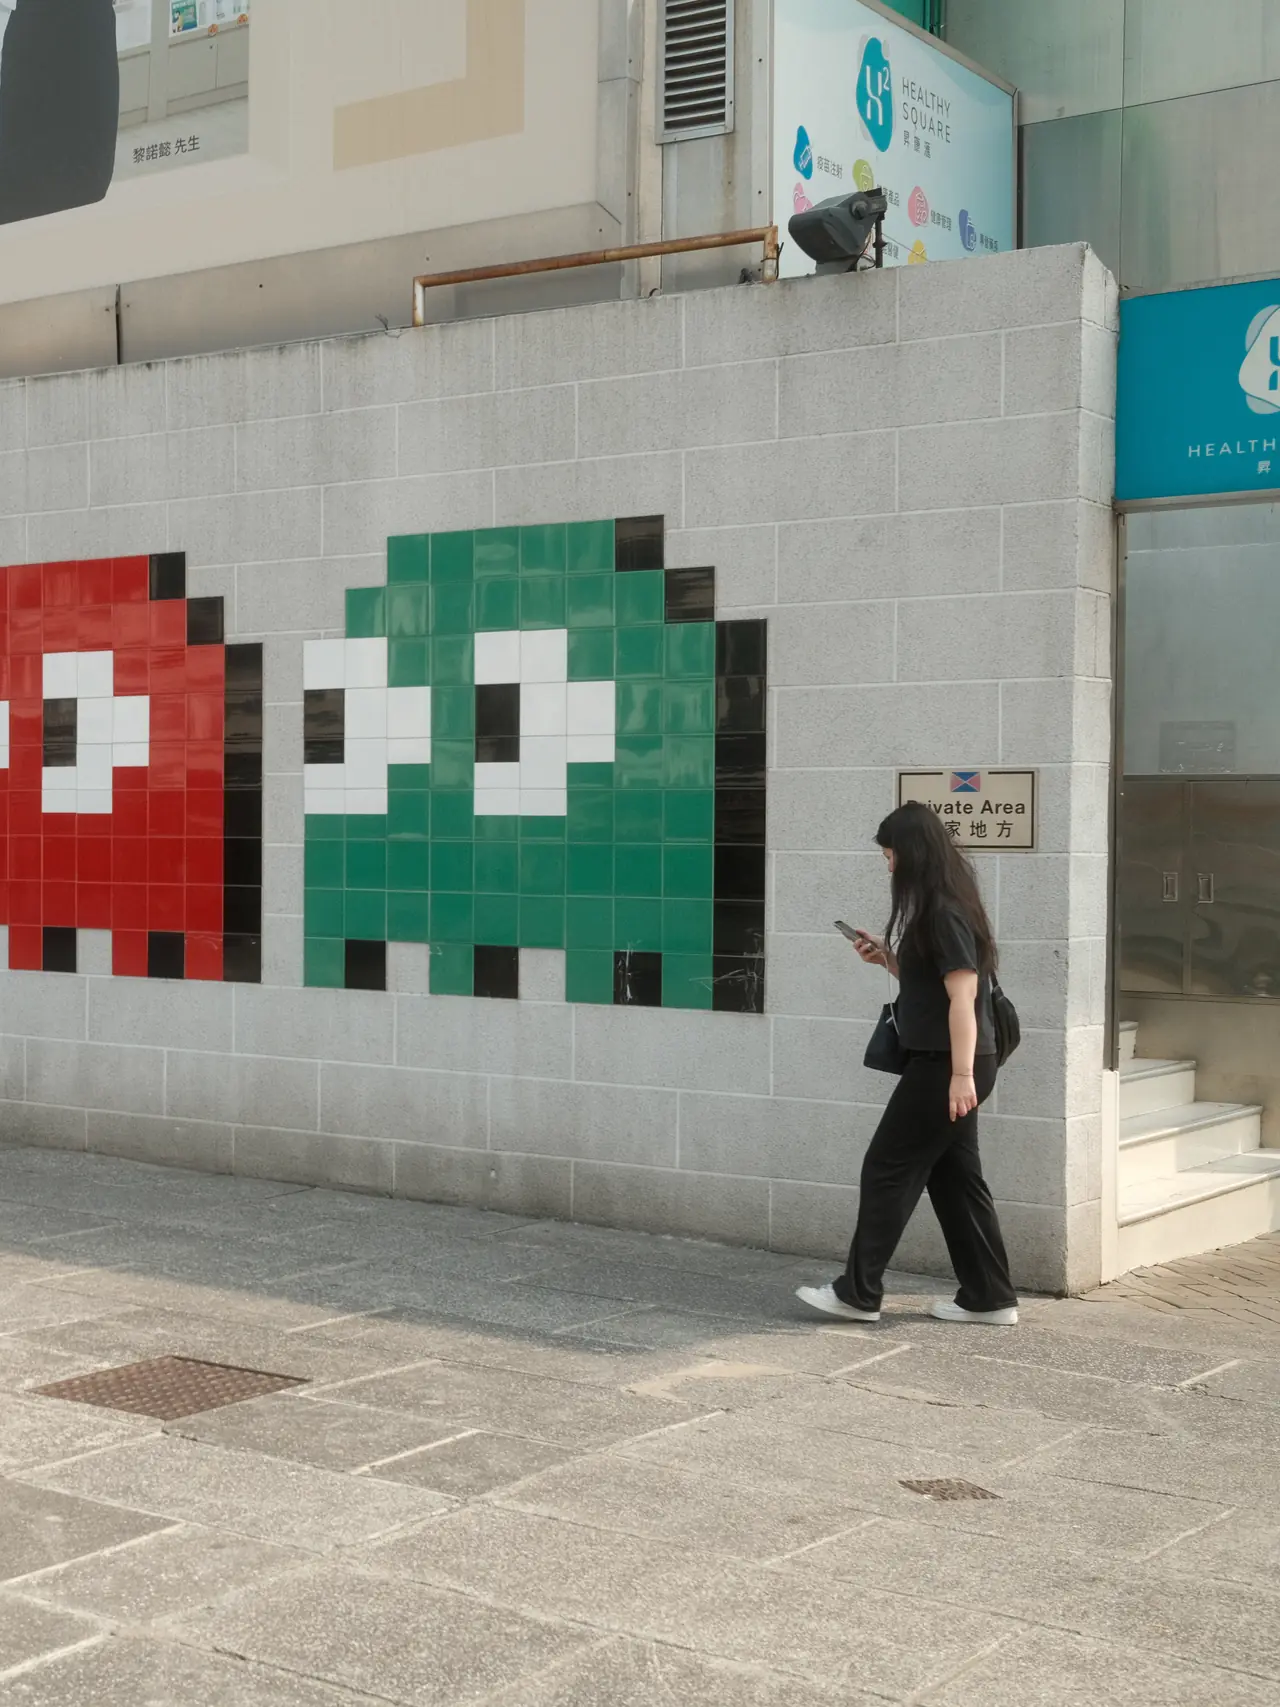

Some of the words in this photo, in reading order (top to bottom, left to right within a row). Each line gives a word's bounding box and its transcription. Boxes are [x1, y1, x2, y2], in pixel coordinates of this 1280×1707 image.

[902, 76, 951, 119] HEALTHY
[902, 102, 951, 144] SQUARE
[175, 135, 200, 155] 先生
[1188, 438, 1276, 457] HEALTH
[907, 800, 973, 814] ivate
[980, 800, 1025, 814] Area
[945, 820, 1013, 838] 家地方
